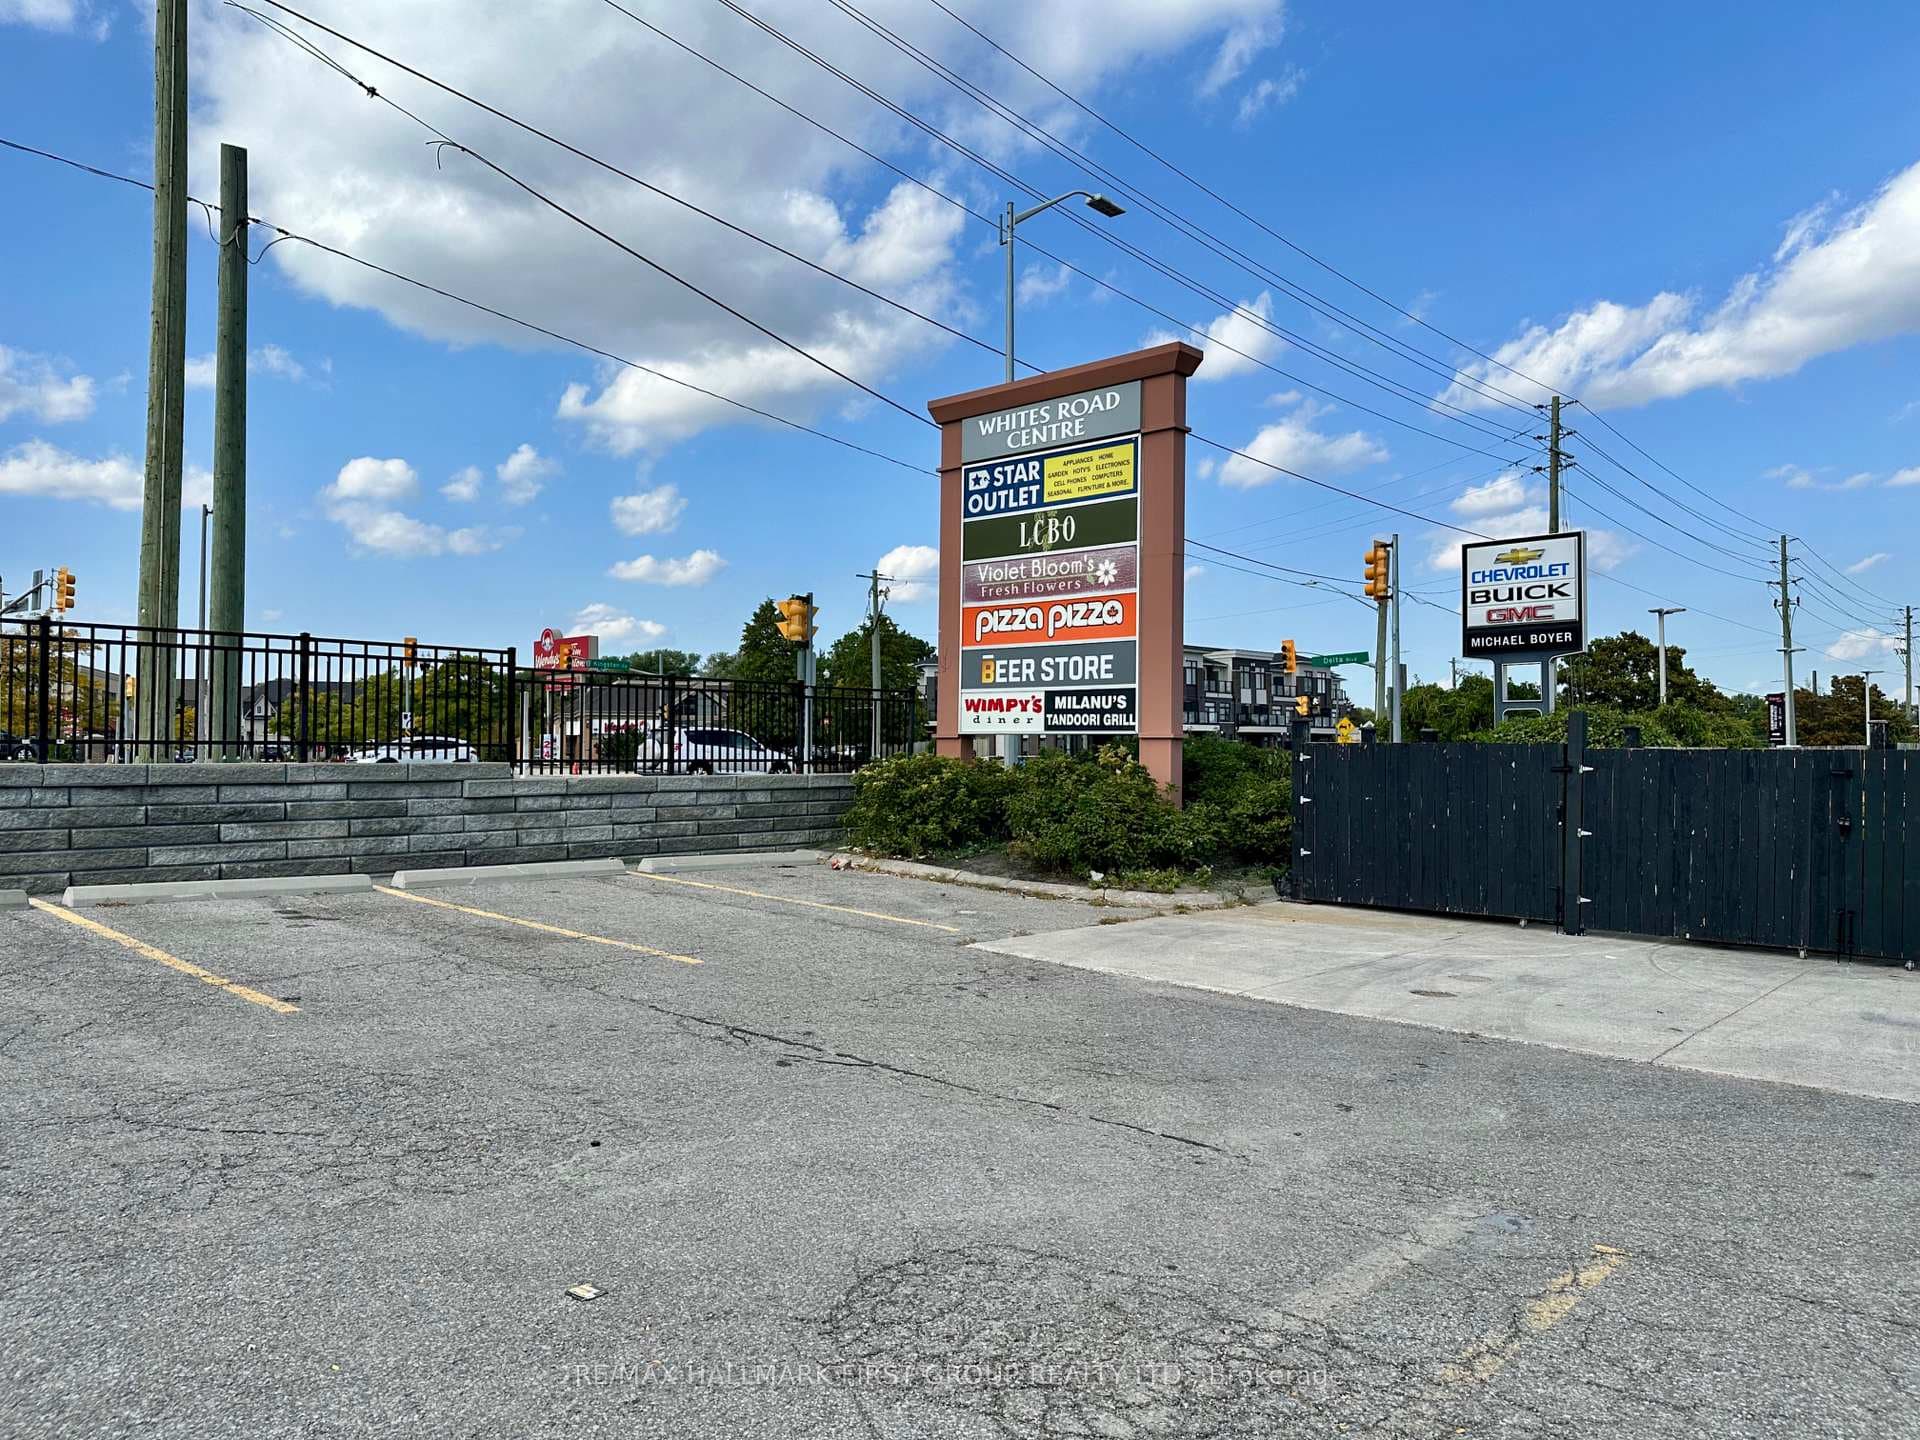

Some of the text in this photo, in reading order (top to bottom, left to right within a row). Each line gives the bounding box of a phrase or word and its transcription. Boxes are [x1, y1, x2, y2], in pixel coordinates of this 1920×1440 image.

[979, 392, 1120, 436] WHITES ROAD
[1006, 418, 1085, 448] CENTRE
[1048, 470, 1068, 479] GARDEN
[1096, 459, 1130, 471] ELECTRONICS
[1063, 452, 1114, 467] APPLIANCES HOME
[993, 461, 1040, 487] STAR
[1067, 476, 1087, 485] PHONES
[1092, 470, 1123, 481] COMPUTERS
[968, 485, 1040, 513] OUTLET
[1048, 488, 1072, 497] SEASONAL
[1078, 482, 1105, 493] FURNITURE
[1019, 515, 1075, 547] LCBO
[978, 555, 1095, 582] Violet Bloom's
[1471, 562, 1570, 584] CHEVROLET
[981, 579, 1081, 597] Fresh Flowers
[1471, 582, 1571, 604] BUICK
[1486, 605, 1555, 624] GMC
[1471, 632, 1573, 648] MICHAEL BOYER
[981, 654, 1114, 684] BEER STORE
[1323, 656, 1344, 665] Delta
[965, 695, 1042, 713] WIMPY'S
[1055, 695, 1127, 710] MILANU'S
[1046, 713, 1136, 726] TANDOORI GRILL
